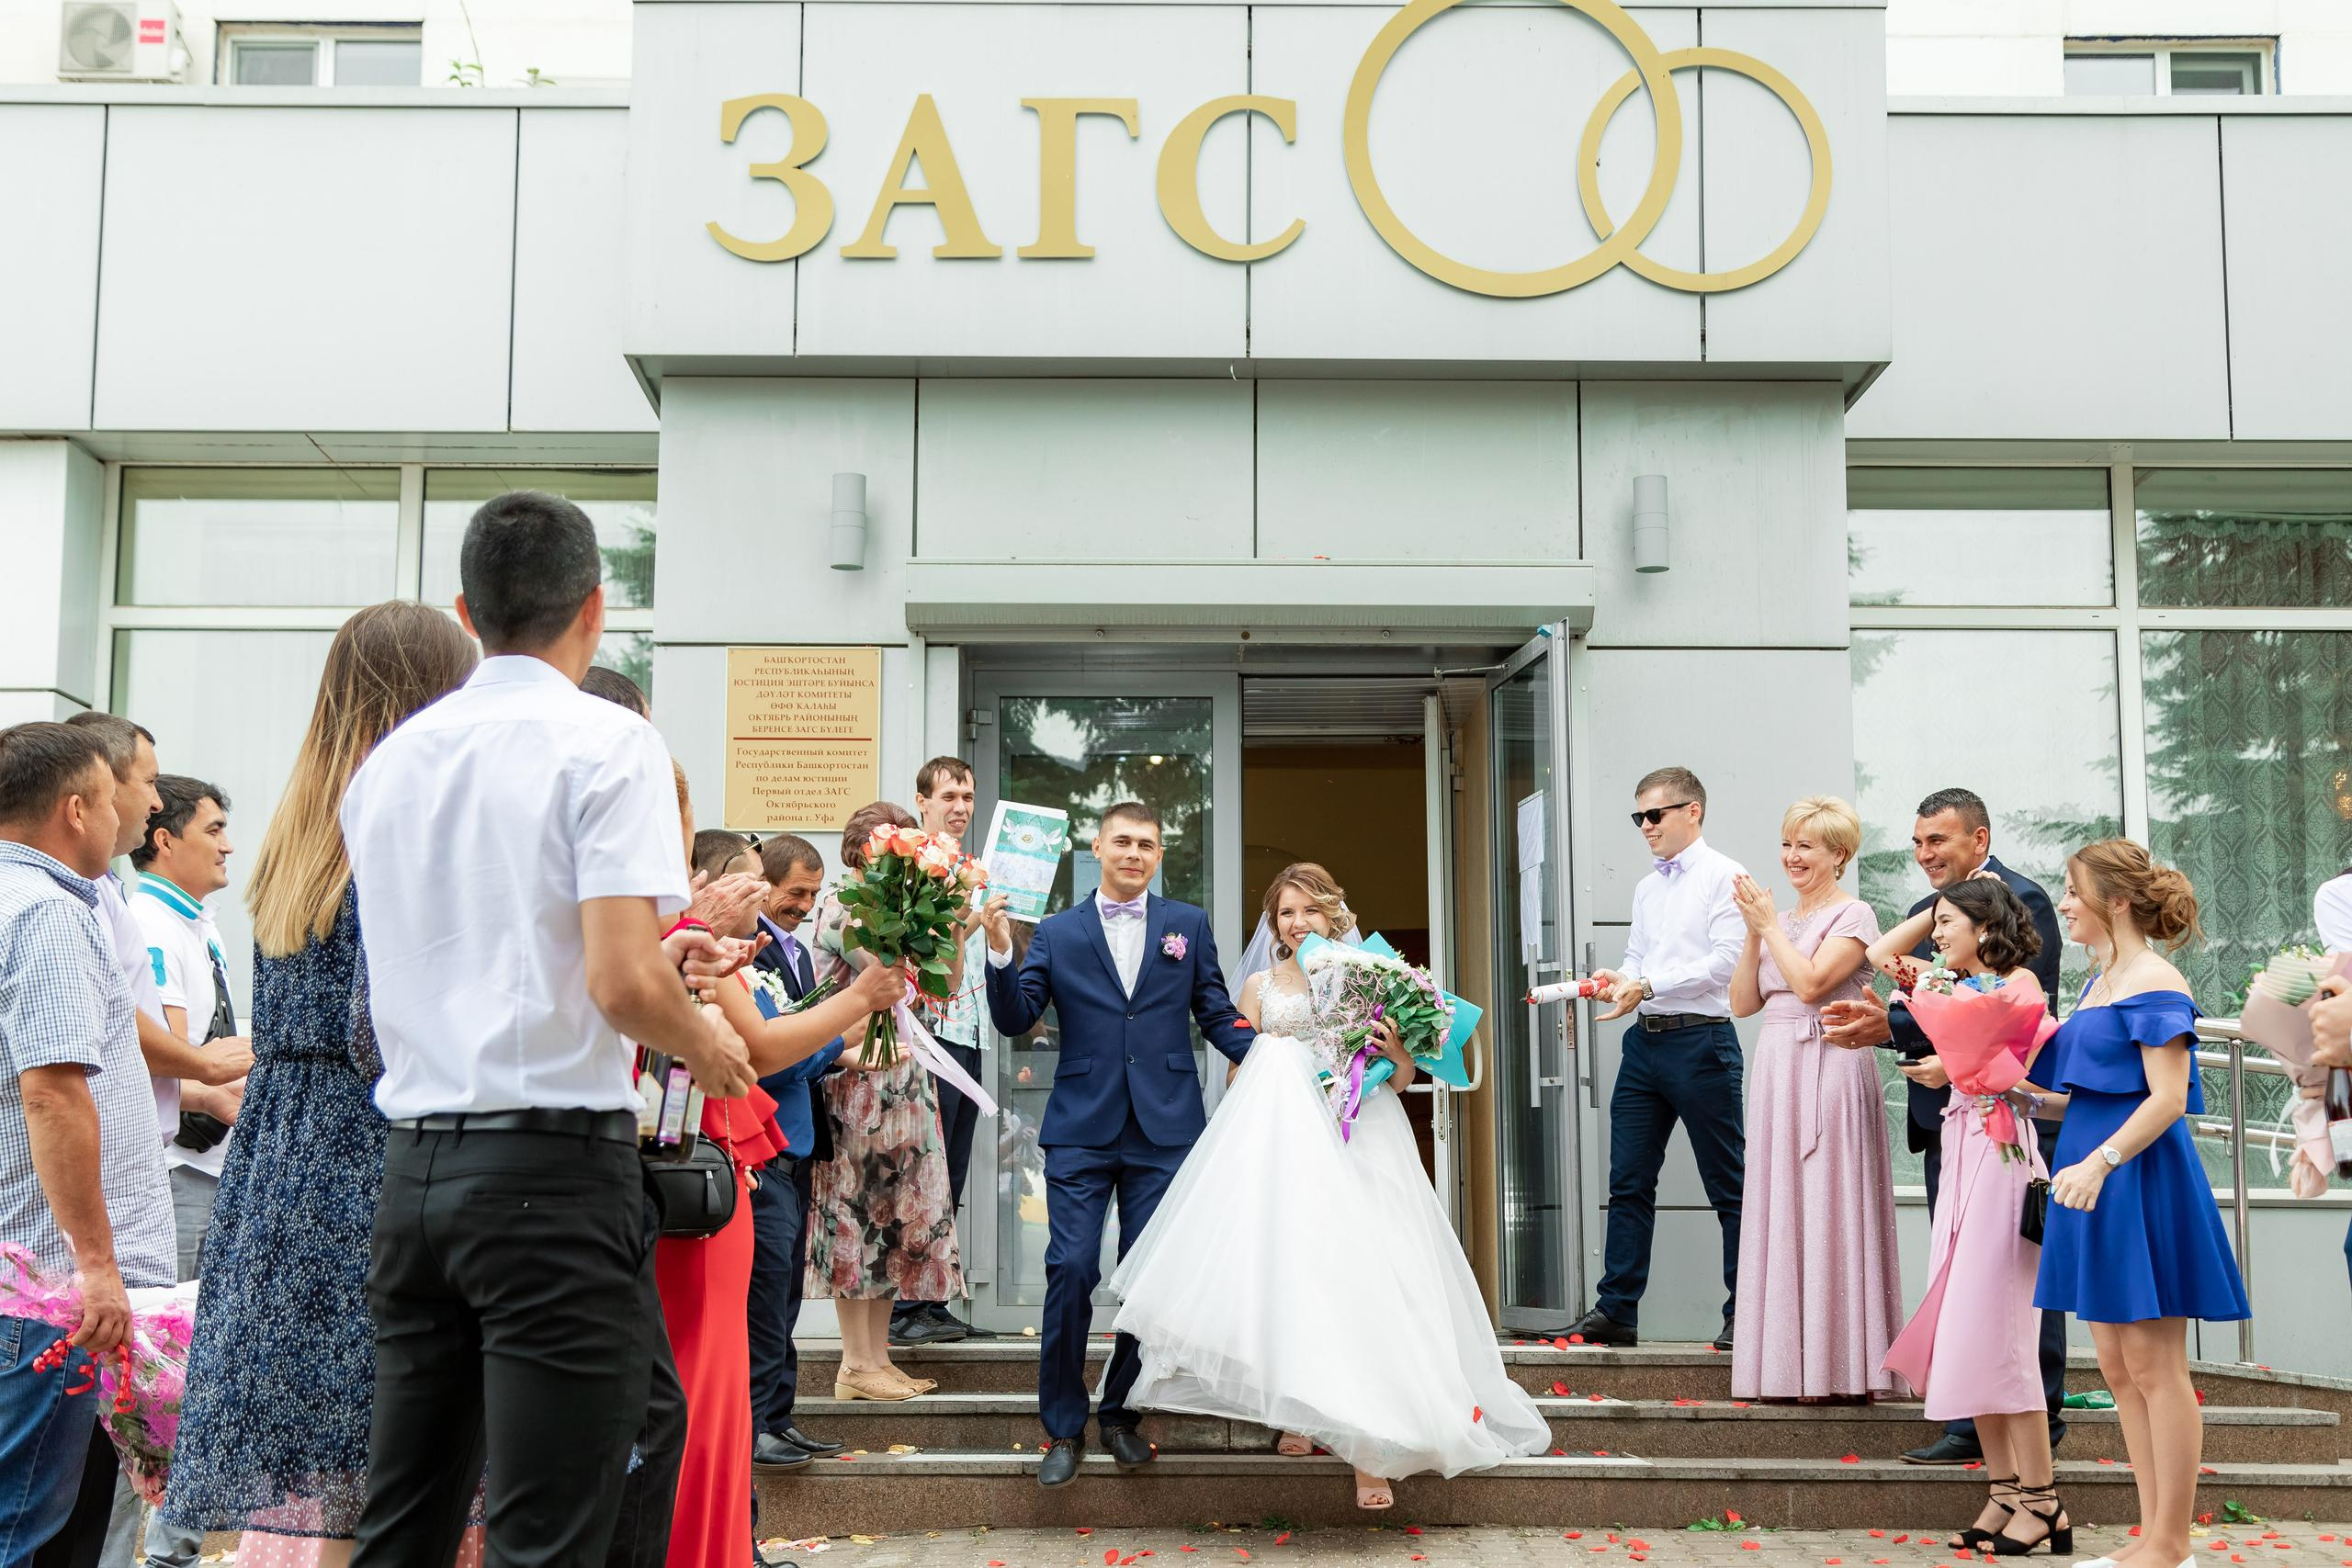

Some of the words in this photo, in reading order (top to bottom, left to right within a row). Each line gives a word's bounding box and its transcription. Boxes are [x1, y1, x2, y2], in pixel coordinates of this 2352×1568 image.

[705, 93, 1306, 263] ЗАГС
[734, 679, 783, 687] ЮСТИЦИЯ
[737, 748, 823, 758] Государственный
[735, 761, 793, 770] Республики
[797, 761, 868, 771] Башкортостан
[752, 787, 791, 797] Первый
[766, 800, 836, 810] Октябрьского
[767, 813, 802, 823] района
[815, 813, 834, 824] Уфа
